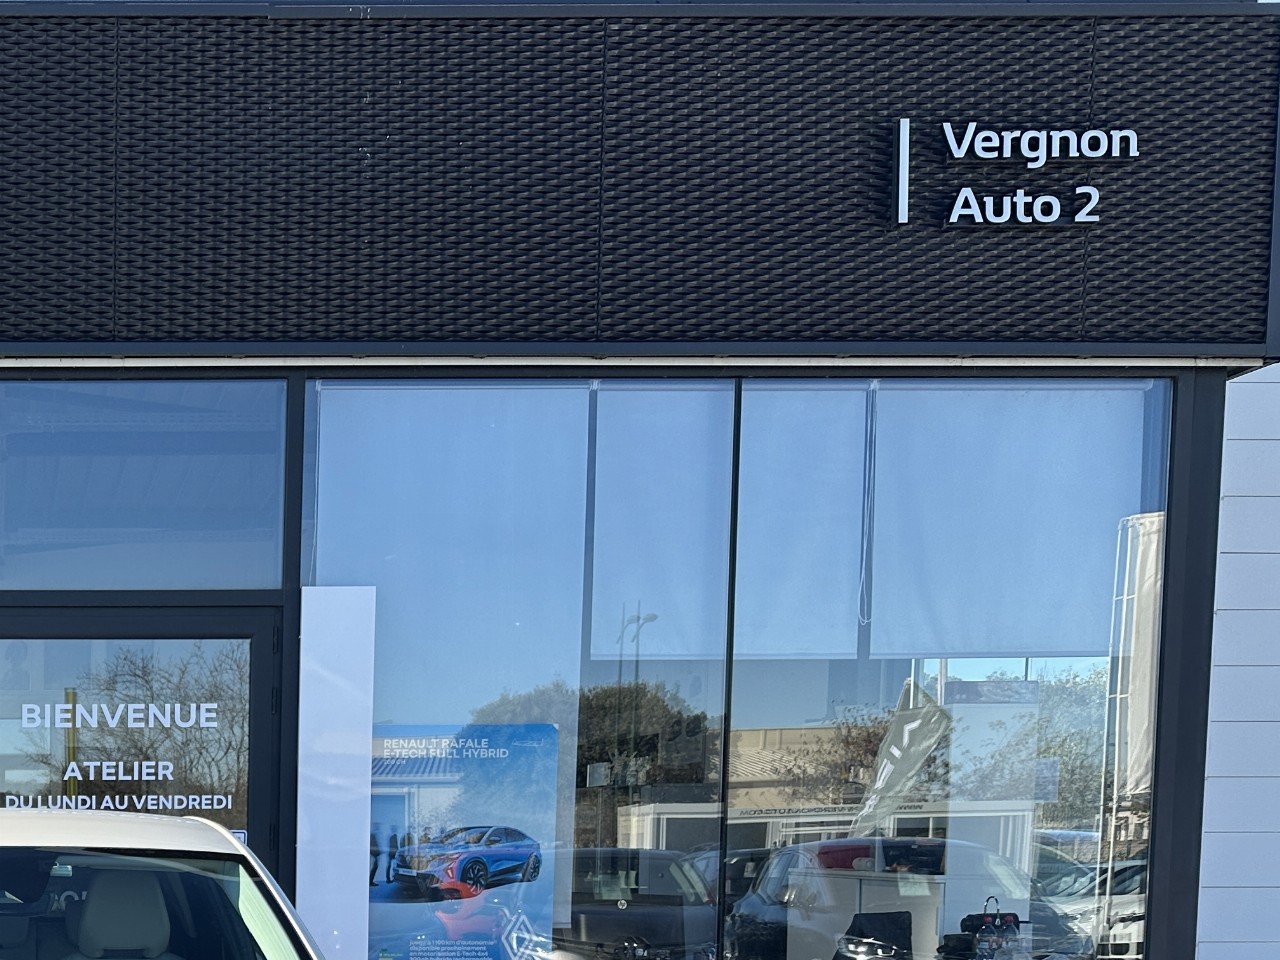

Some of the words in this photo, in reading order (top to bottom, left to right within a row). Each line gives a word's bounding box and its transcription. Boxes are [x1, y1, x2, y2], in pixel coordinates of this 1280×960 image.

[942, 121, 1140, 169] Vergnon
[948, 187, 1061, 223] Auto
[1074, 185, 1100, 222] 2
[21, 703, 219, 728] BIENVENUE
[383, 738, 439, 749] RENAULT
[441, 738, 489, 749] RAFALE
[383, 749, 426, 758] E-TECH
[429, 749, 460, 758] FULL
[463, 749, 509, 758] HYBRID
[63, 761, 174, 781] ATELIER
[5, 795, 33, 809] DU
[37, 795, 96, 809] LUNDI
[100, 795, 129, 810] AU
[132, 795, 233, 810] VENDREDI
